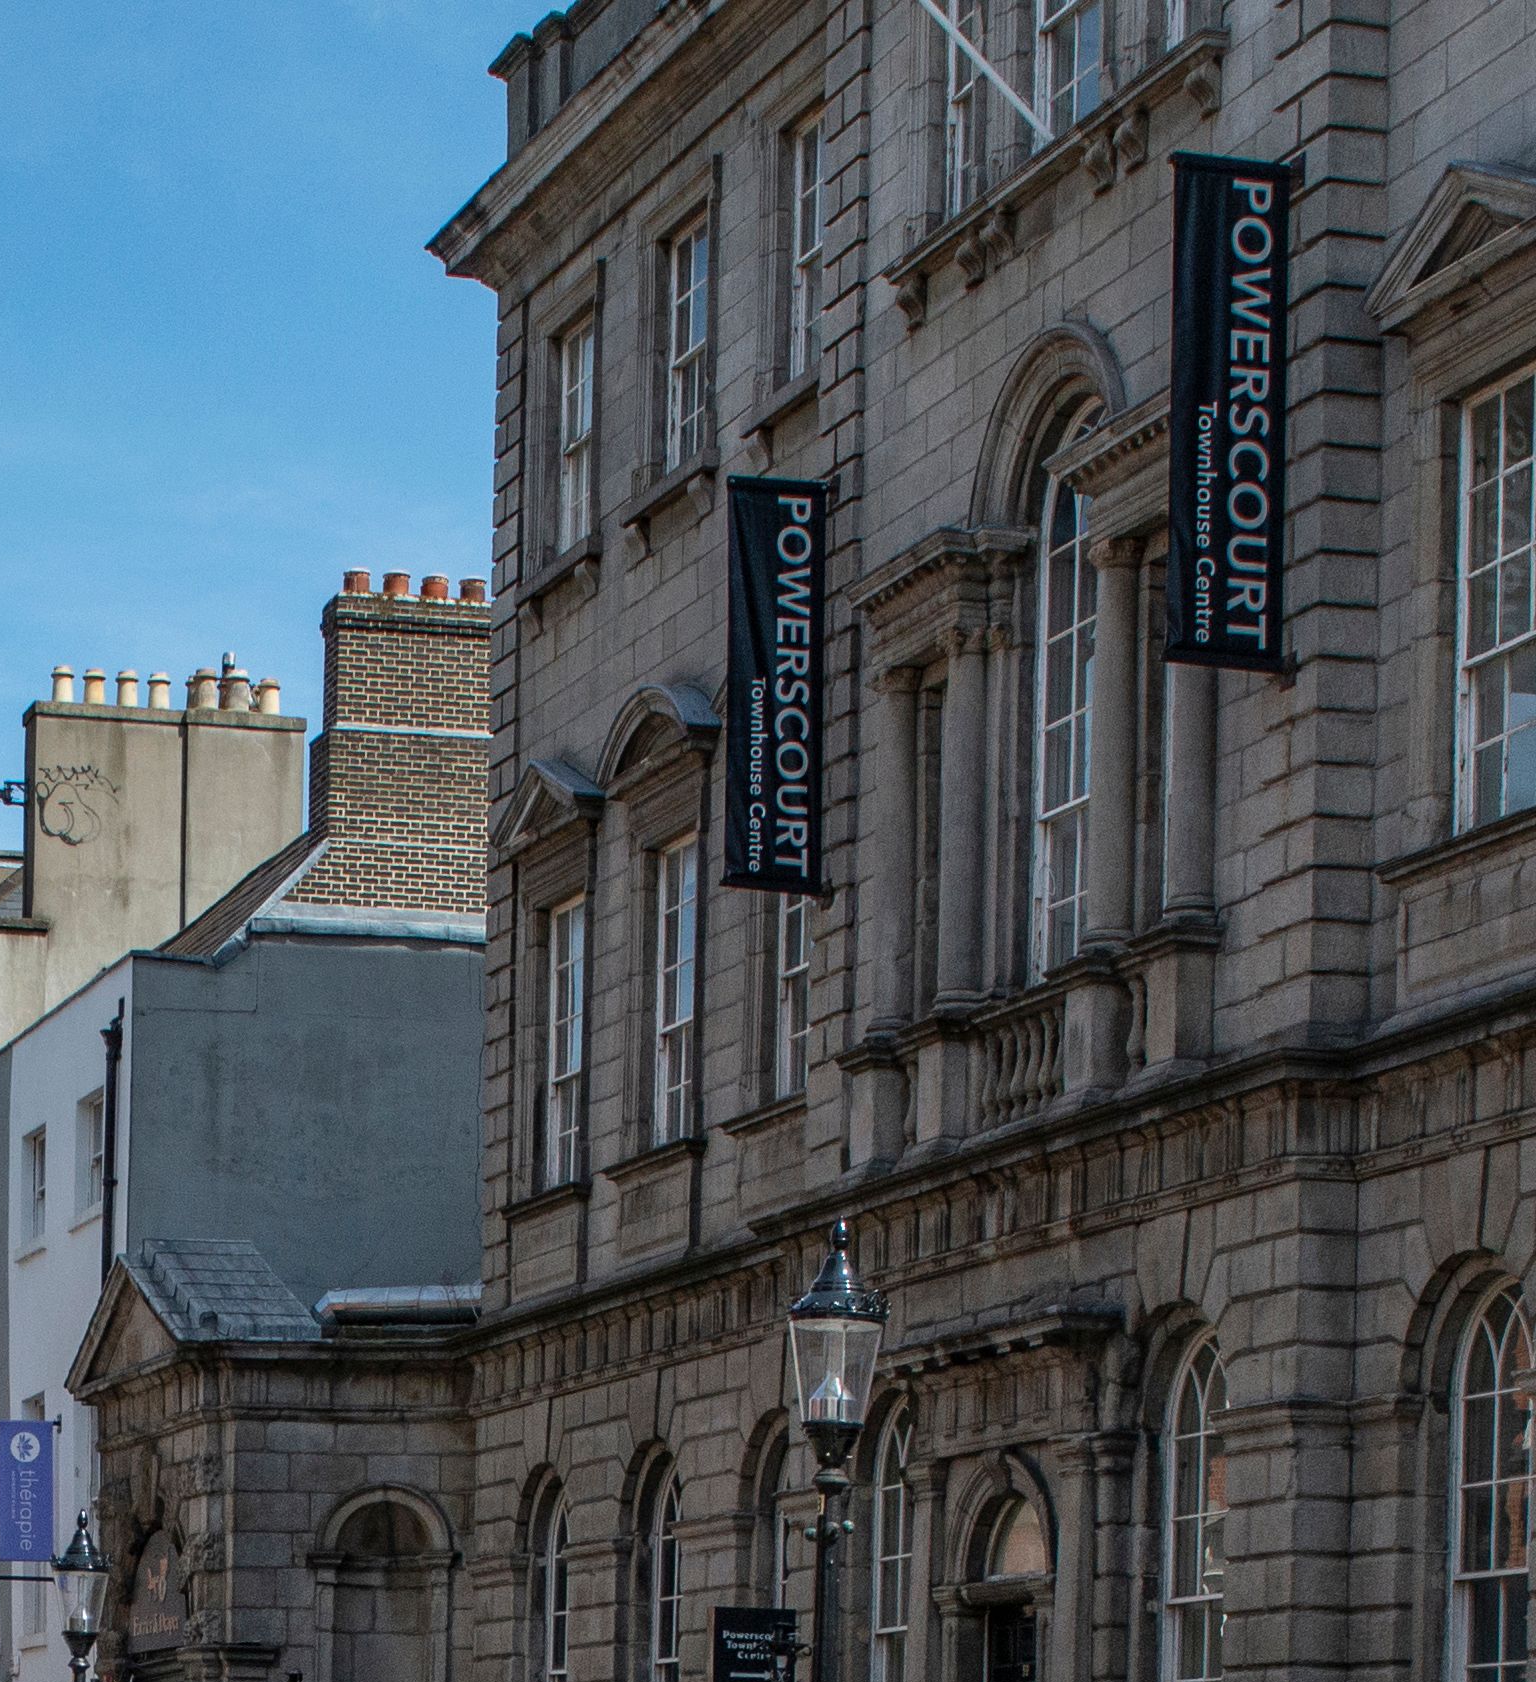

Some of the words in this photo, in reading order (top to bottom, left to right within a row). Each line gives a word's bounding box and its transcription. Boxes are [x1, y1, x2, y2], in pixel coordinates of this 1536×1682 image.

[1226, 176, 1273, 651] POWERSCOURT
[1193, 400, 1218, 549] Townhouse
[1193, 555, 1216, 645] Centre
[747, 675, 767, 795] Townhouse
[773, 494, 813, 878] POWERSCOURT
[746, 804, 764, 873] Centre
[14, 1469, 39, 1552] thérapie
